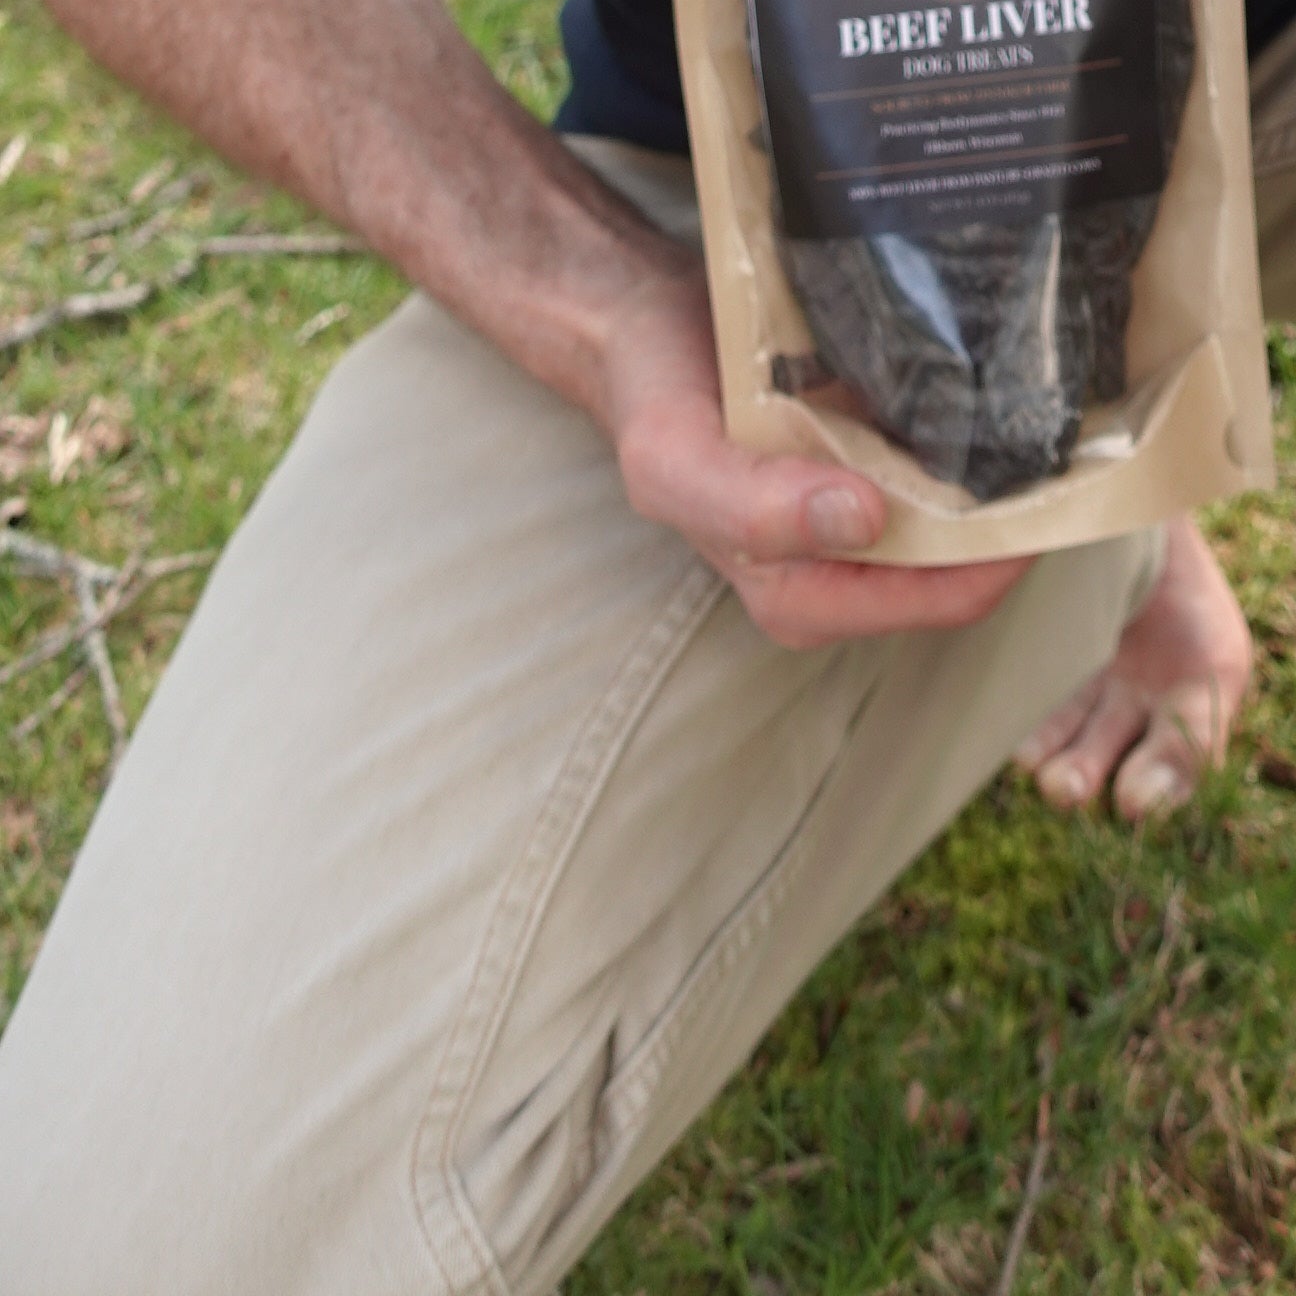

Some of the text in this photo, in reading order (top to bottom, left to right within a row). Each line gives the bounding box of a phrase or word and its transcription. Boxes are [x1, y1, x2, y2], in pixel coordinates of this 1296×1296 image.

[838, 7, 952, 58] BEEF
[902, 43, 1035, 80] DOG TREATS
